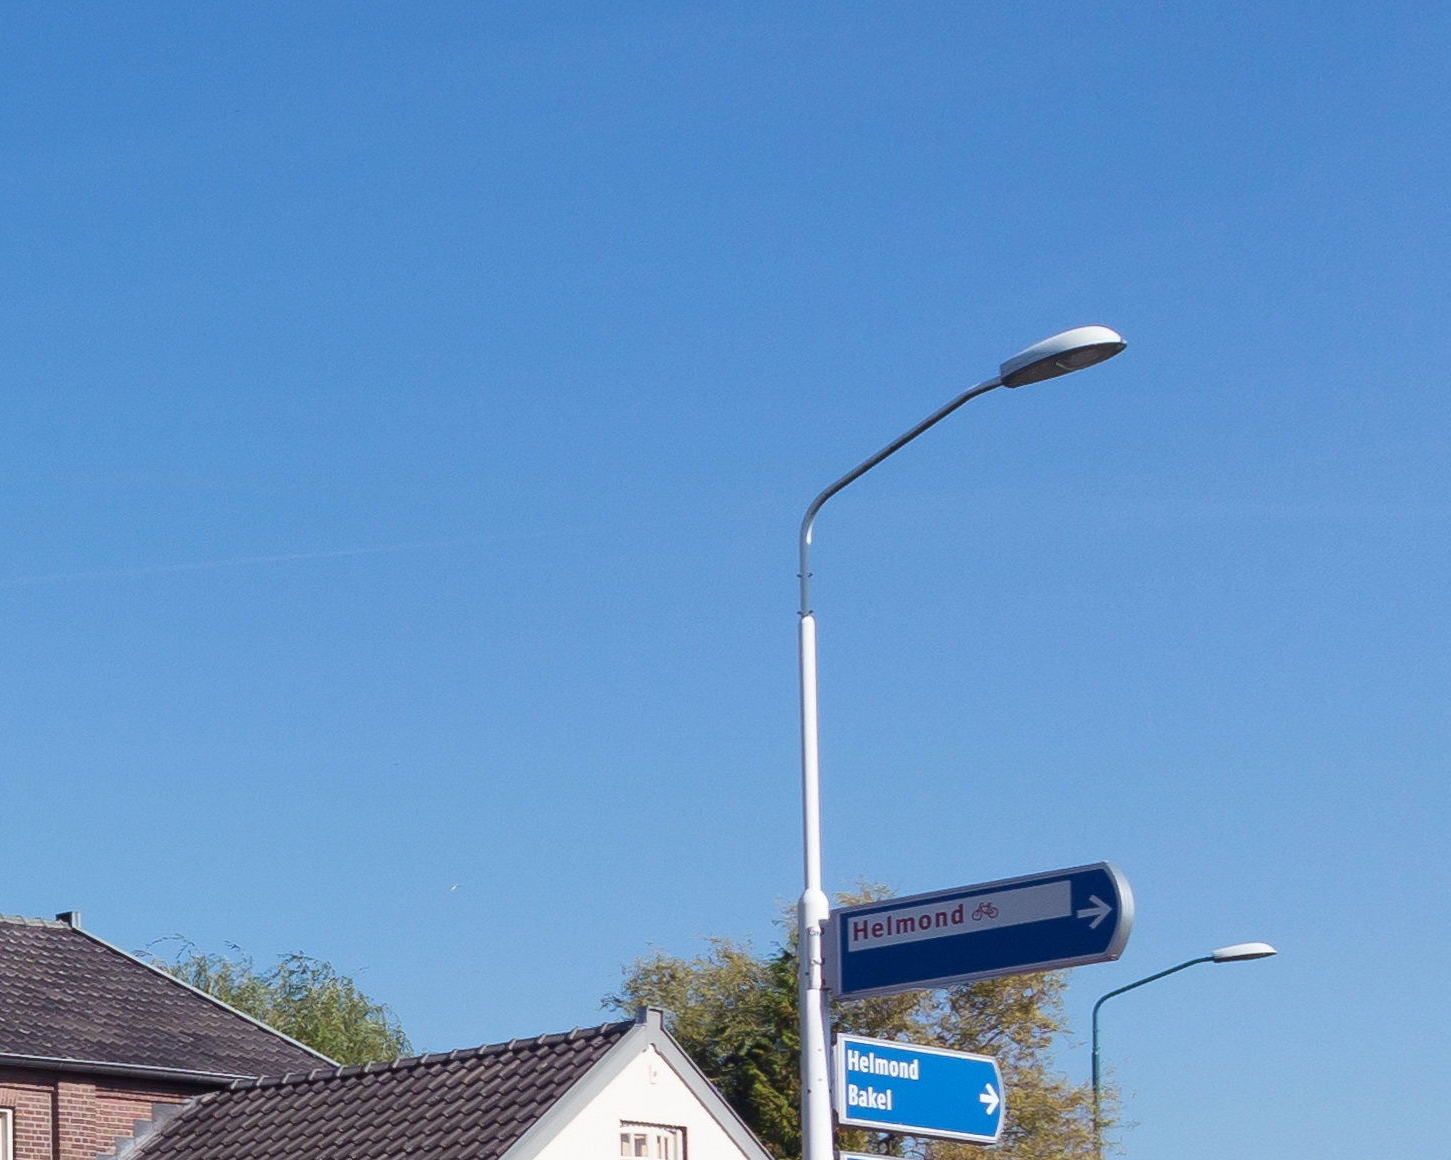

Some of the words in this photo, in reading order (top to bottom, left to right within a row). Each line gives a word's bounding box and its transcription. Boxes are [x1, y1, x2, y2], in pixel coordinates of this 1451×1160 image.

[852, 904, 965, 942] Helmond
[847, 1050, 920, 1080] Helmond
[848, 1084, 893, 1111] Bakel
